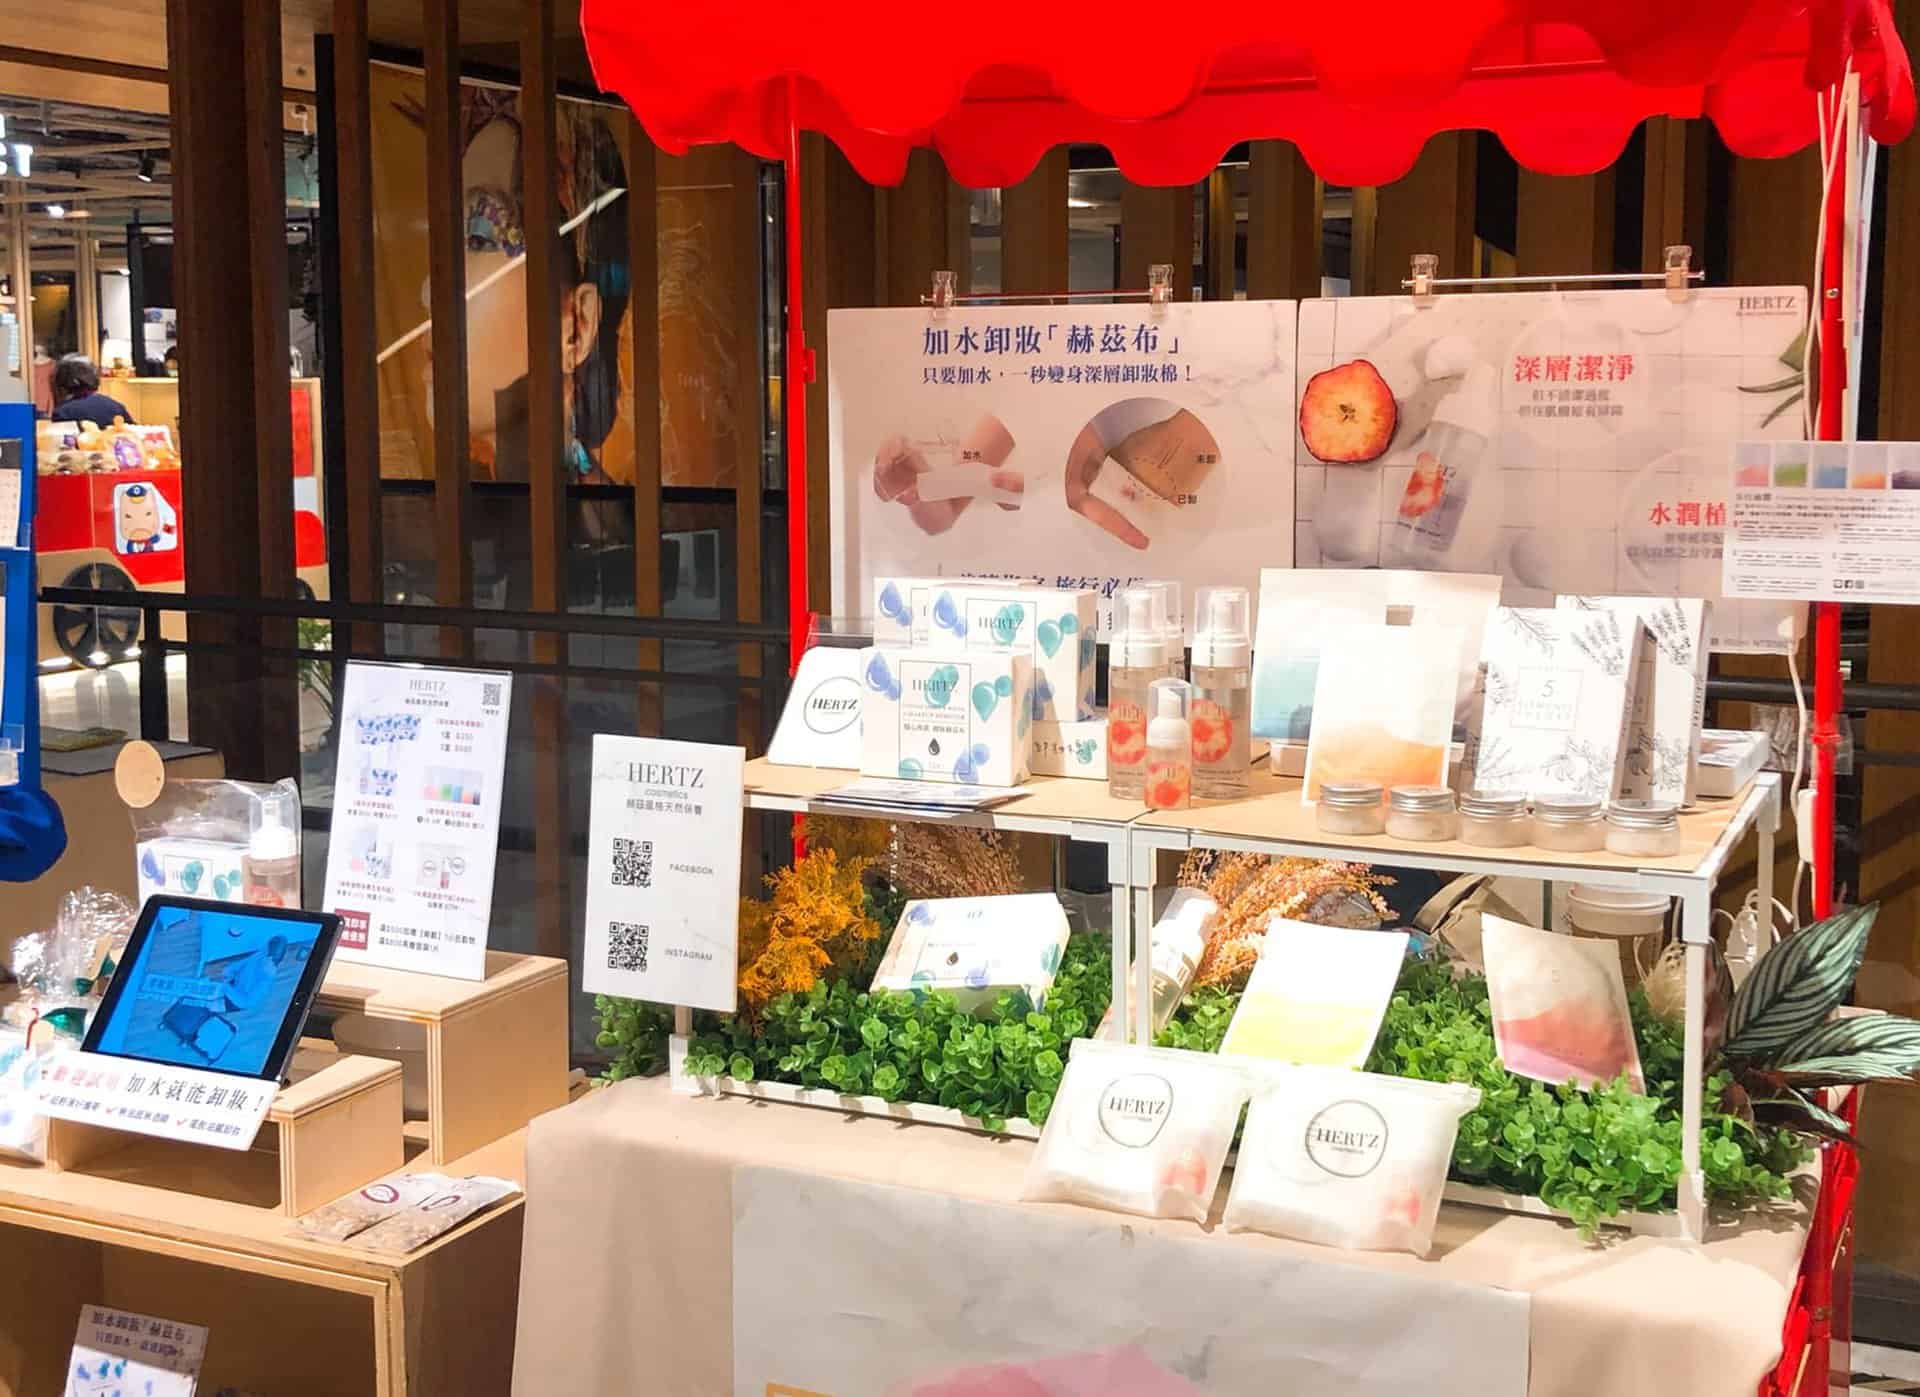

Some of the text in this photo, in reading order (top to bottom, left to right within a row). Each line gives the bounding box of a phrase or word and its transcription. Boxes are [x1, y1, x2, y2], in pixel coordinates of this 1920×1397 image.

[1739, 296, 1797, 310] HERTZ
[922, 324, 1180, 356] 加水卸妝「赫茲布」
[1514, 354, 1634, 382] 深層潔淨
[812, 697, 859, 712] HERTZ
[627, 762, 704, 789] HERTZ
[669, 863, 714, 876] FACEBOOK
[664, 948, 713, 962] INSTAGRAM
[1109, 1096, 1166, 1115] HERTZ
[1317, 1127, 1379, 1149] HERTZ
